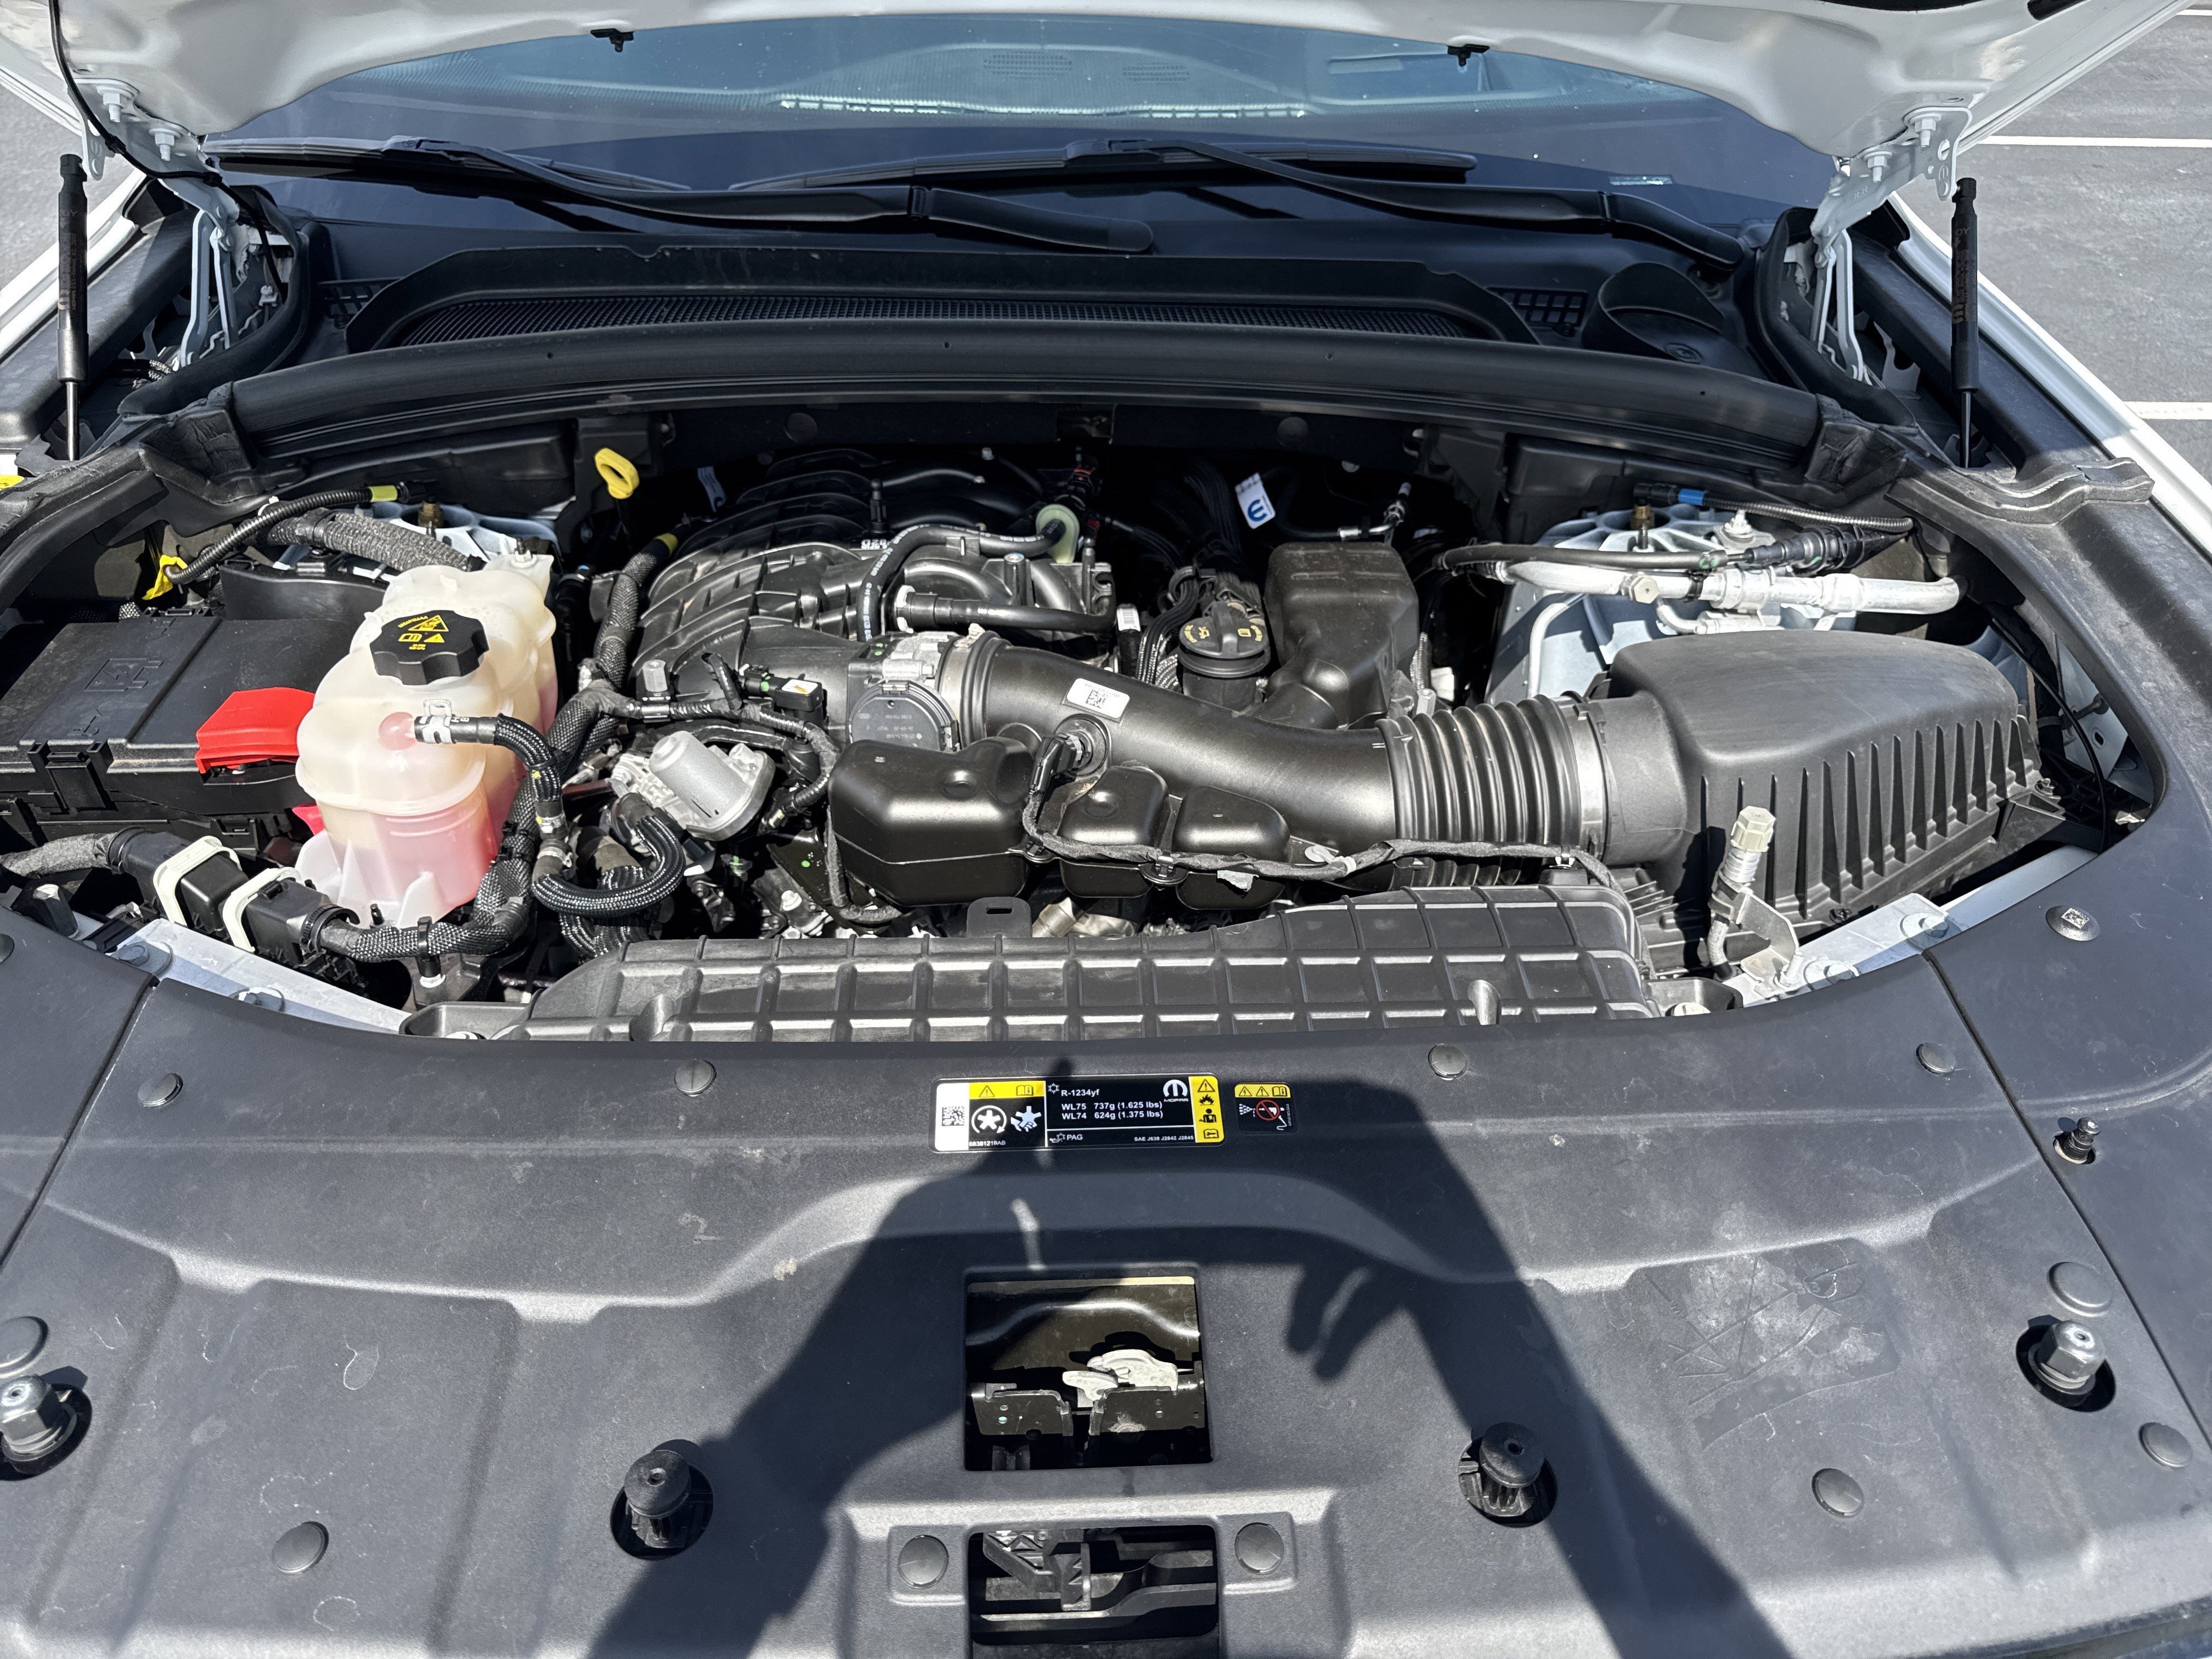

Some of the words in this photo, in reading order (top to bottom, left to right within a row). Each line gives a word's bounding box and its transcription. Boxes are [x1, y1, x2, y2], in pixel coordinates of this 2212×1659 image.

[1061, 1088, 1100, 1097] R-1234yf
[1093, 1102, 1115, 1110] 737g
[1118, 1102, 1144, 1110] (1.625
[1146, 1101, 1163, 1109] lbs)
[1094, 1111, 1115, 1120] 624g
[1118, 1111, 1144, 1119] (1.375
[1147, 1110, 1164, 1119] lbs)
